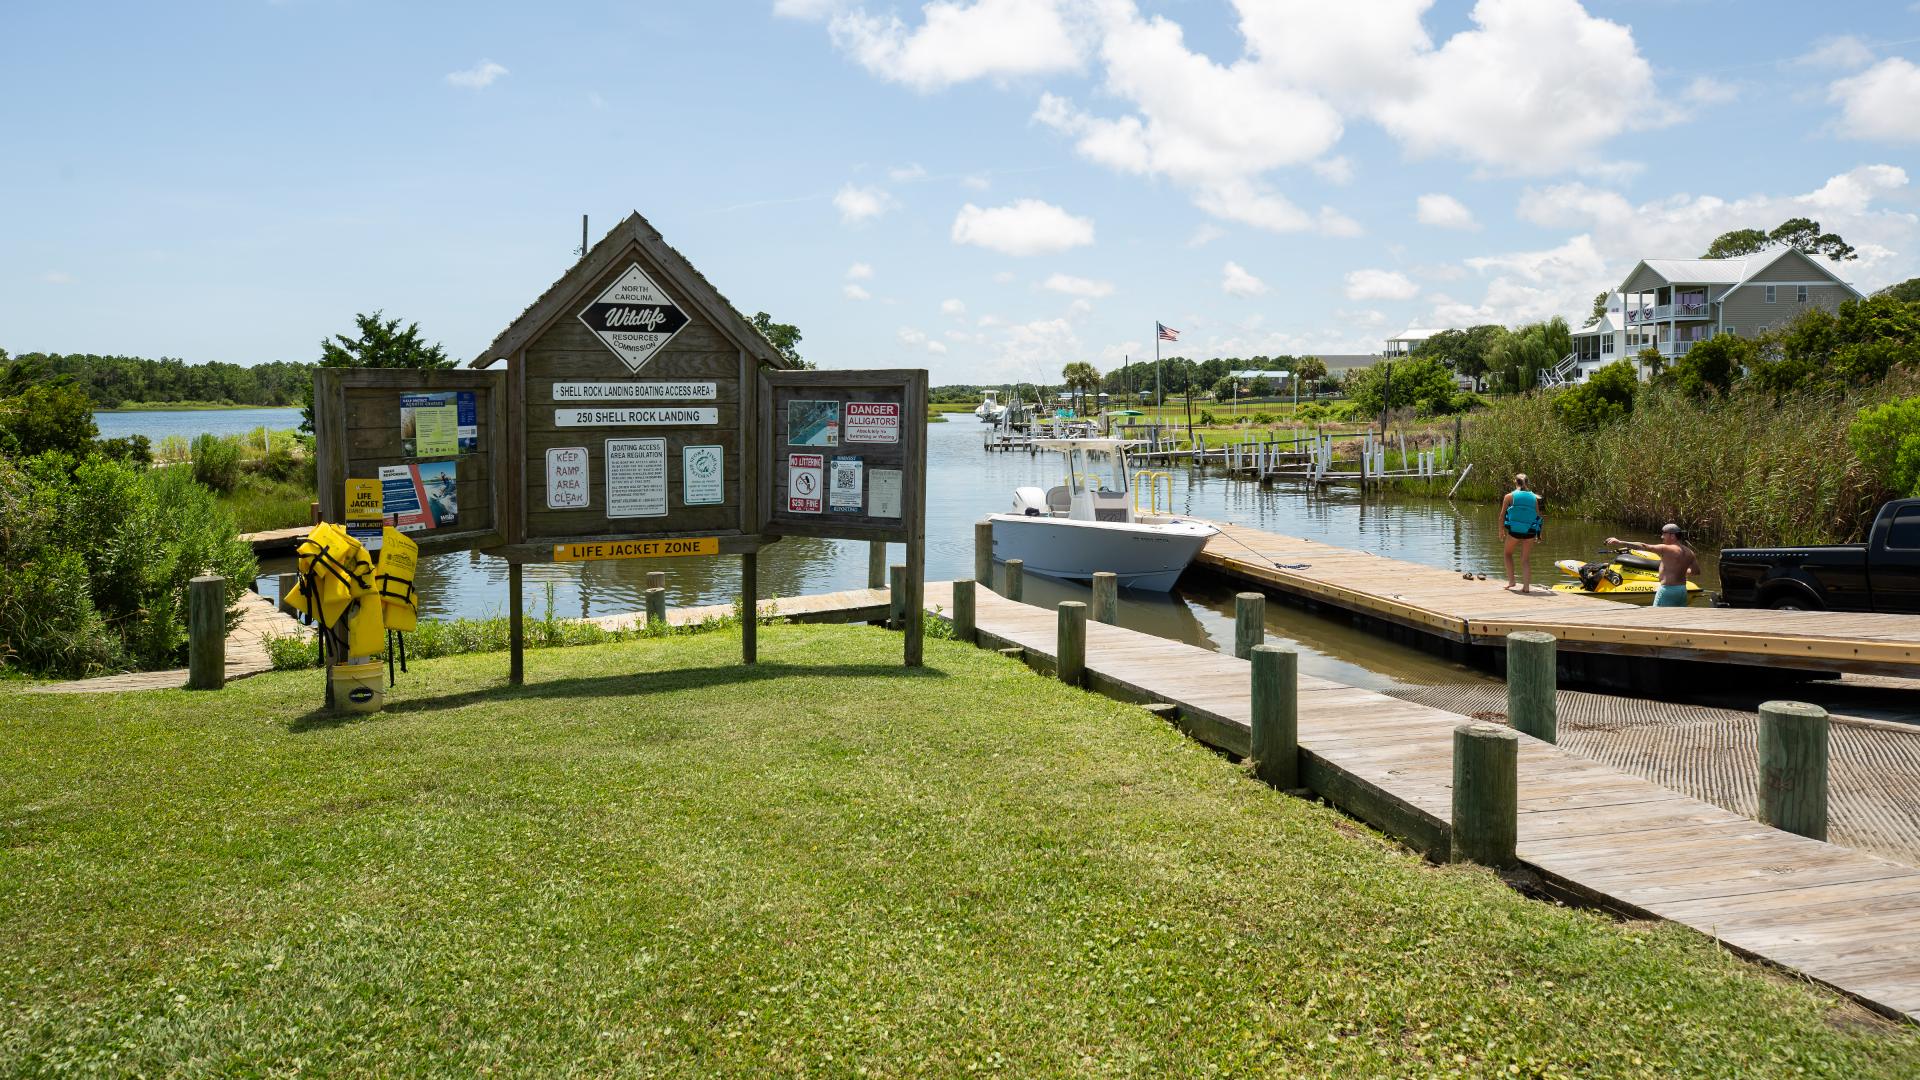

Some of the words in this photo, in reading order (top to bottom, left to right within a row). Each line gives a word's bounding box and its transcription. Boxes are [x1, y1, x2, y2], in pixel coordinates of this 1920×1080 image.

[615, 293, 653, 301] CAROLINA
[605, 306, 666, 331] Wildlife
[613, 340, 656, 352] COMMISSION
[560, 385, 582, 397] SHELL
[583, 385, 603, 397] ROCK
[604, 385, 634, 396] LANDING
[635, 385, 664, 396] BOATING
[665, 385, 692, 396] ACCESS
[692, 385, 710, 395] AREA
[851, 405, 894, 415] DANGER
[577, 412, 593, 423] 250
[595, 412, 626, 422] SHELL
[629, 411, 656, 422] ROCK
[658, 411, 700, 421] LANDING
[848, 417, 896, 425] ALLIGATORS
[556, 453, 579, 462] KEEP
[790, 457, 798, 466] NO
[799, 457, 821, 467] LITTERING
[556, 466, 580, 476] RAMP
[556, 480, 580, 489] AREA
[554, 493, 584, 502] CLEAR
[350, 500, 379, 508] JACKET
[806, 499, 819, 507] FINE
[573, 546, 603, 558] LIFE
[608, 543, 660, 556] JACKET
[664, 541, 701, 554] ZONE
